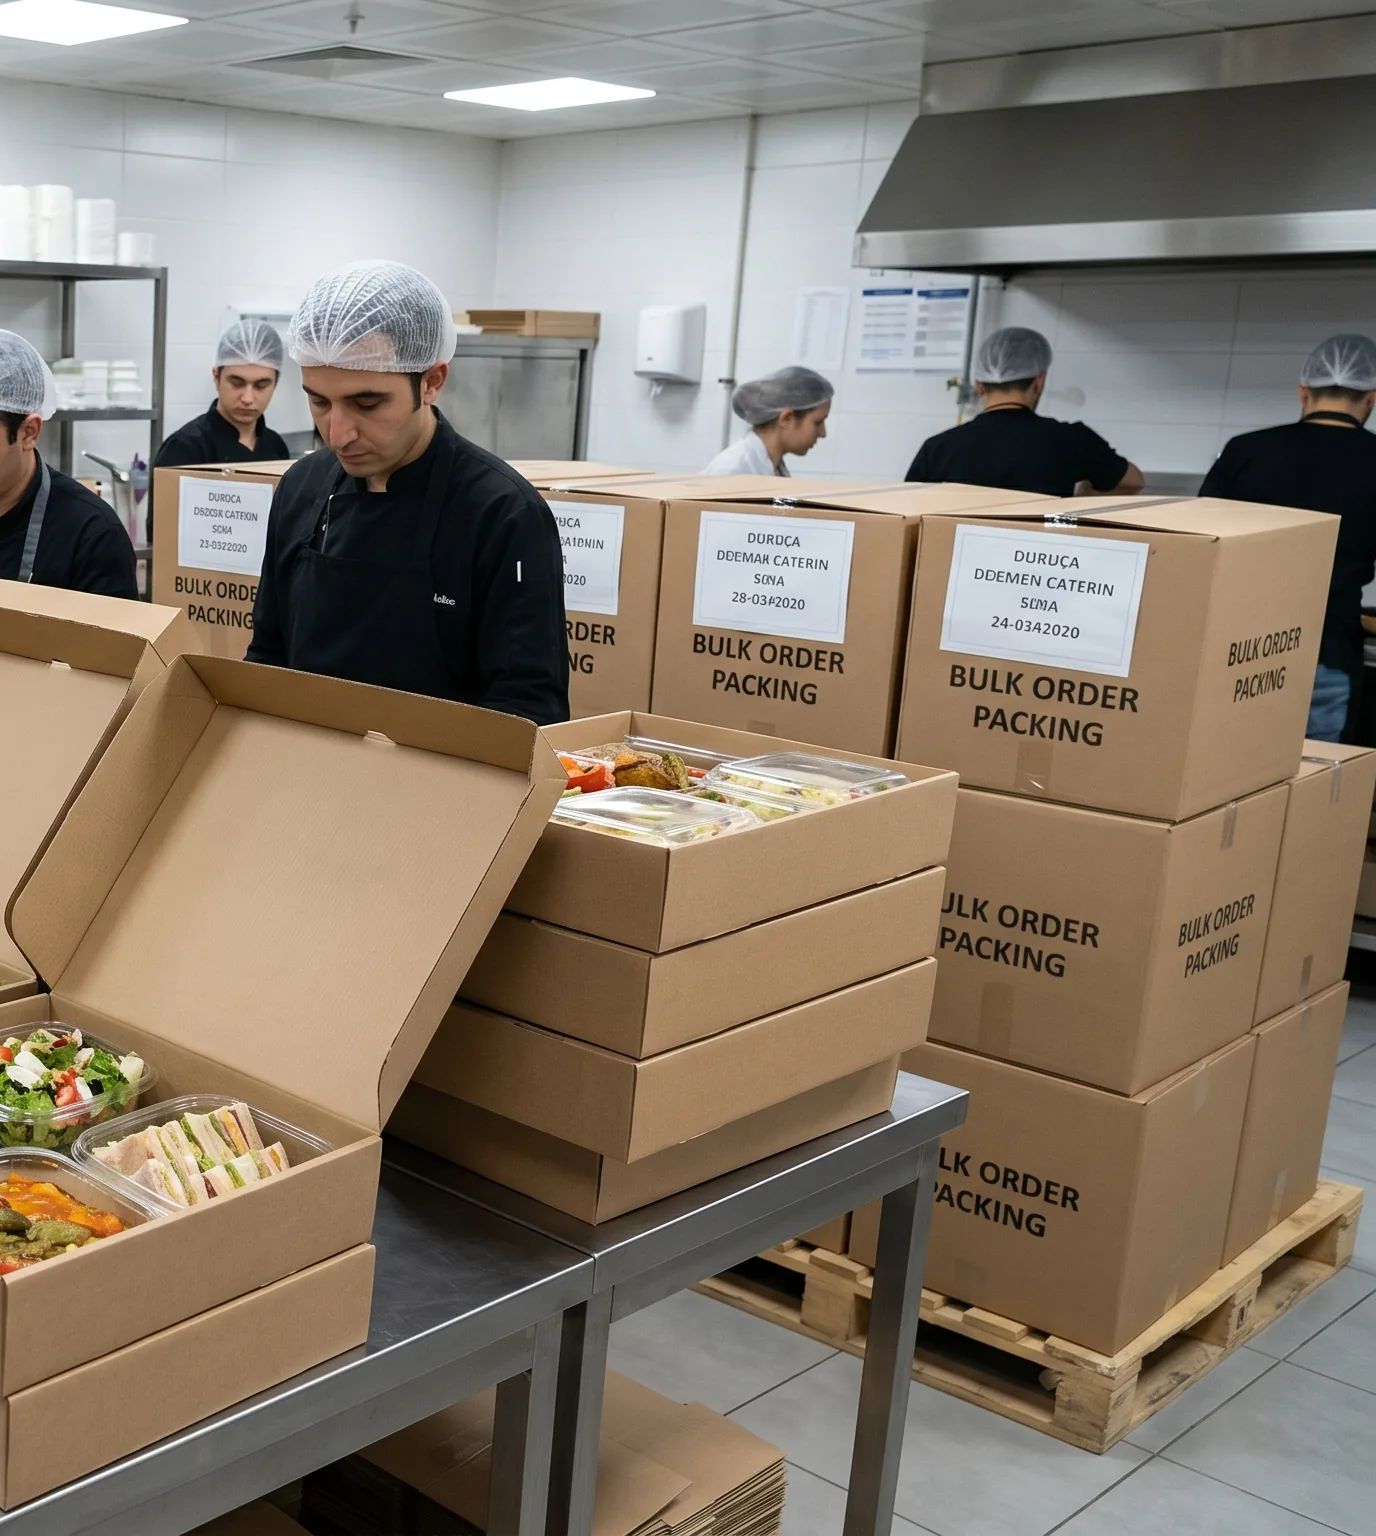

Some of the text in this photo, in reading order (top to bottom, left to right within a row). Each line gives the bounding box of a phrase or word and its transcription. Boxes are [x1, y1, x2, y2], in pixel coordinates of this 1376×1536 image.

[773, 555, 829, 571] CATERIN
[1014, 550, 1080, 569] DURUÇA
[175, 576, 258, 603] BULK ORDE
[1046, 577, 1114, 597] CATERIN
[188, 604, 253, 630] PACKING
[565, 620, 616, 647] RDER
[693, 633, 845, 674] BULK ORDER
[1227, 626, 1302, 667] BULK ORDER
[712, 669, 818, 705] PACKING
[949, 664, 1139, 713] BULK ORDER
[1233, 666, 1286, 703] PACKING
[973, 705, 1104, 747] PACKING
[940, 892, 1100, 948] ULK ORDER
[1177, 893, 1255, 948] BULK ORDER
[939, 926, 1066, 978] PACKING
[1184, 933, 1240, 978] PACKING
[938, 1147, 1080, 1212] LK ORDER
